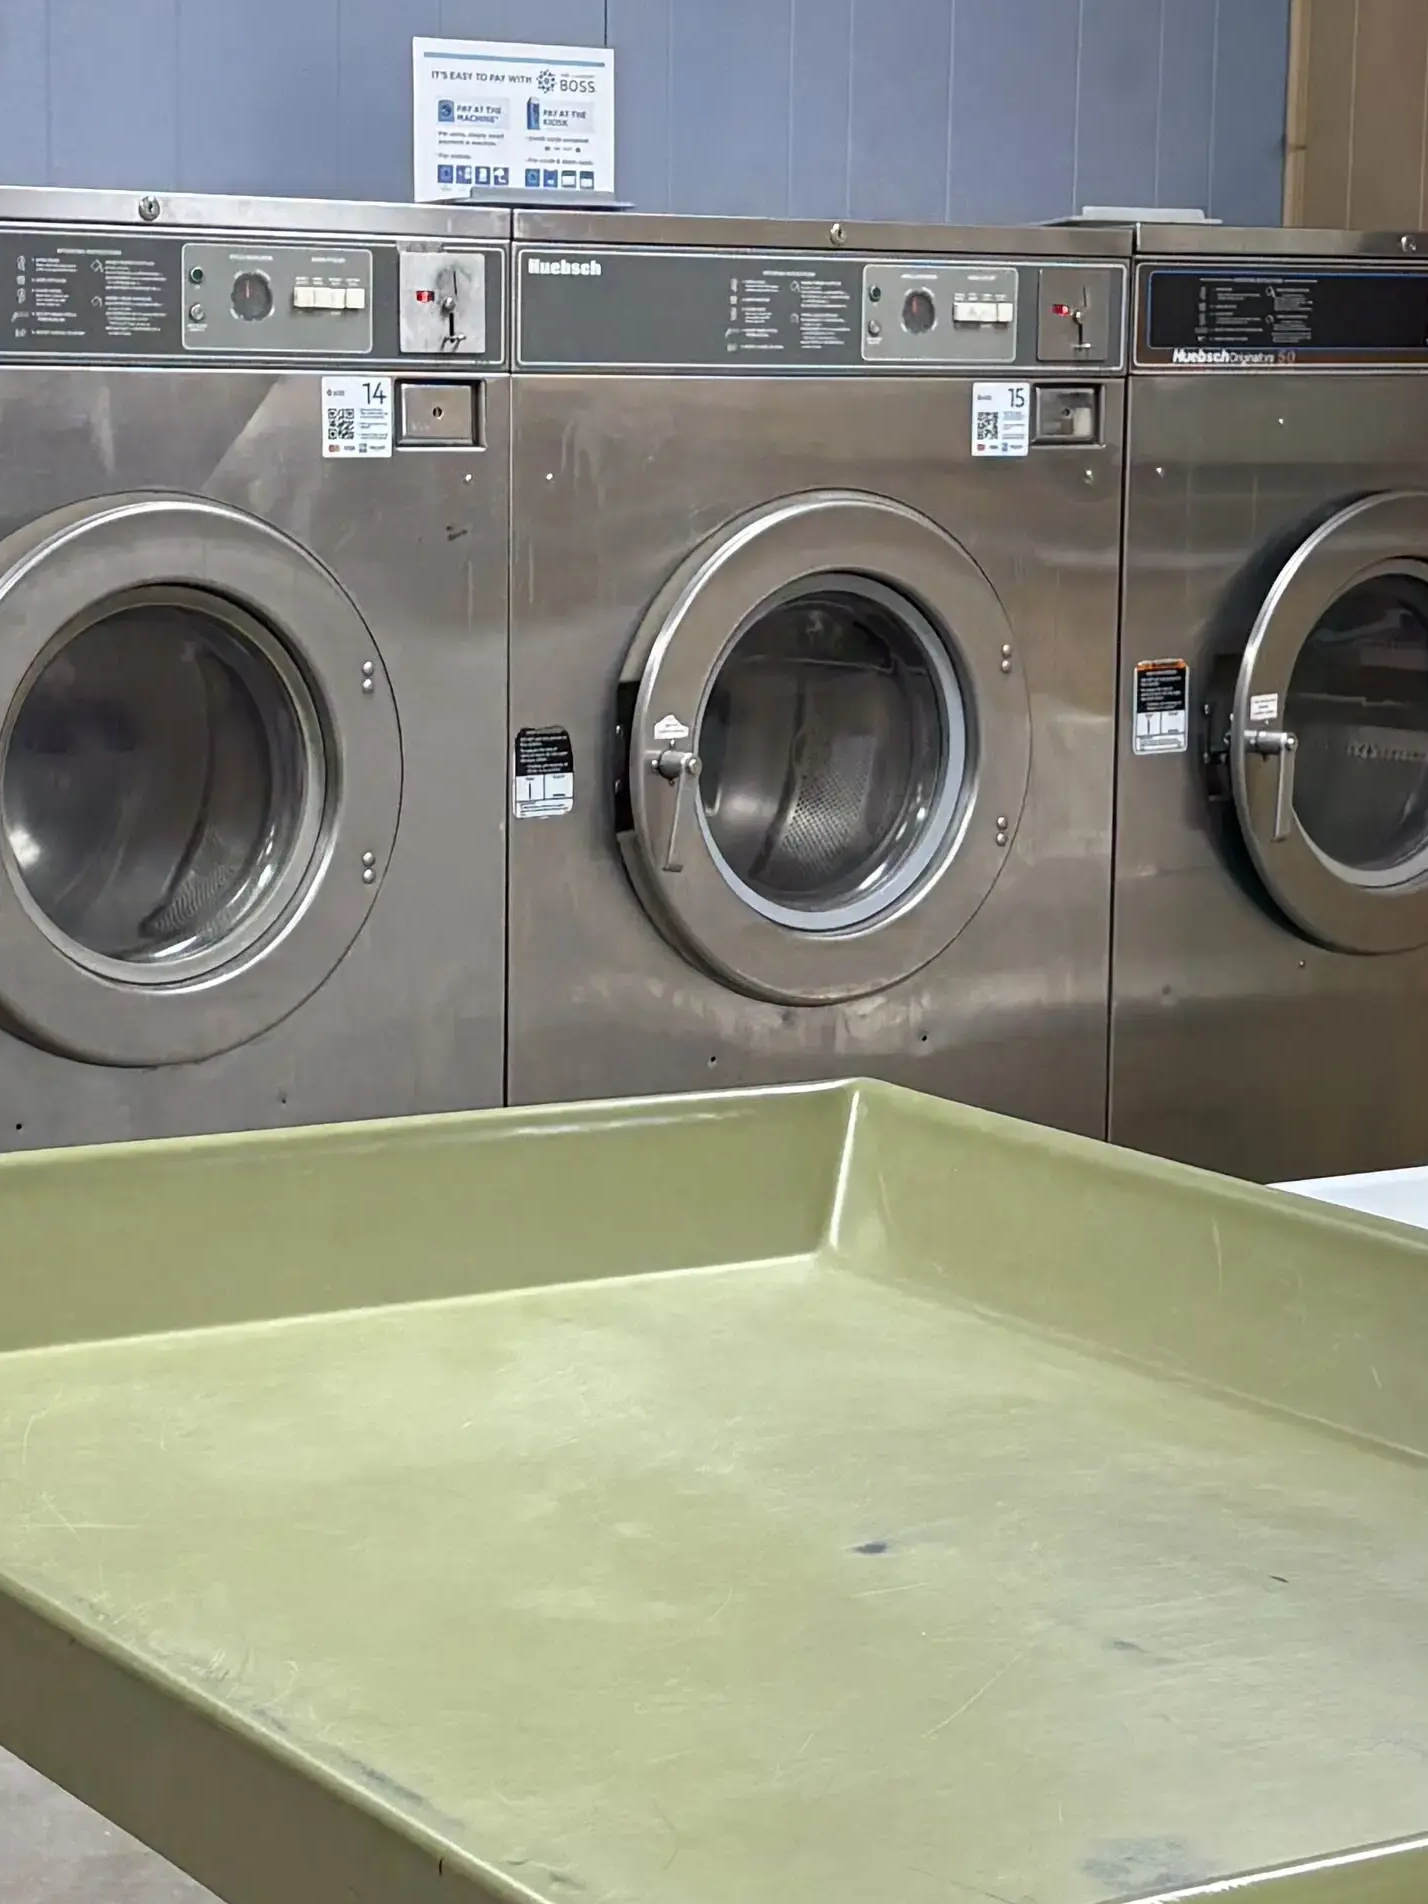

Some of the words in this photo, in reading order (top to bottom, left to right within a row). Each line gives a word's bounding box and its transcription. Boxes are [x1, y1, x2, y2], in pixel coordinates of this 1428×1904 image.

[450, 71, 473, 82] EASY
[476, 72, 488, 82] TO
[489, 73, 506, 83] PAY
[508, 74, 532, 84] WITH
[559, 79, 596, 93] BOSS
[527, 257, 602, 276] Huebsch
[362, 382, 387, 405] 14
[1007, 387, 1025, 408] 15
